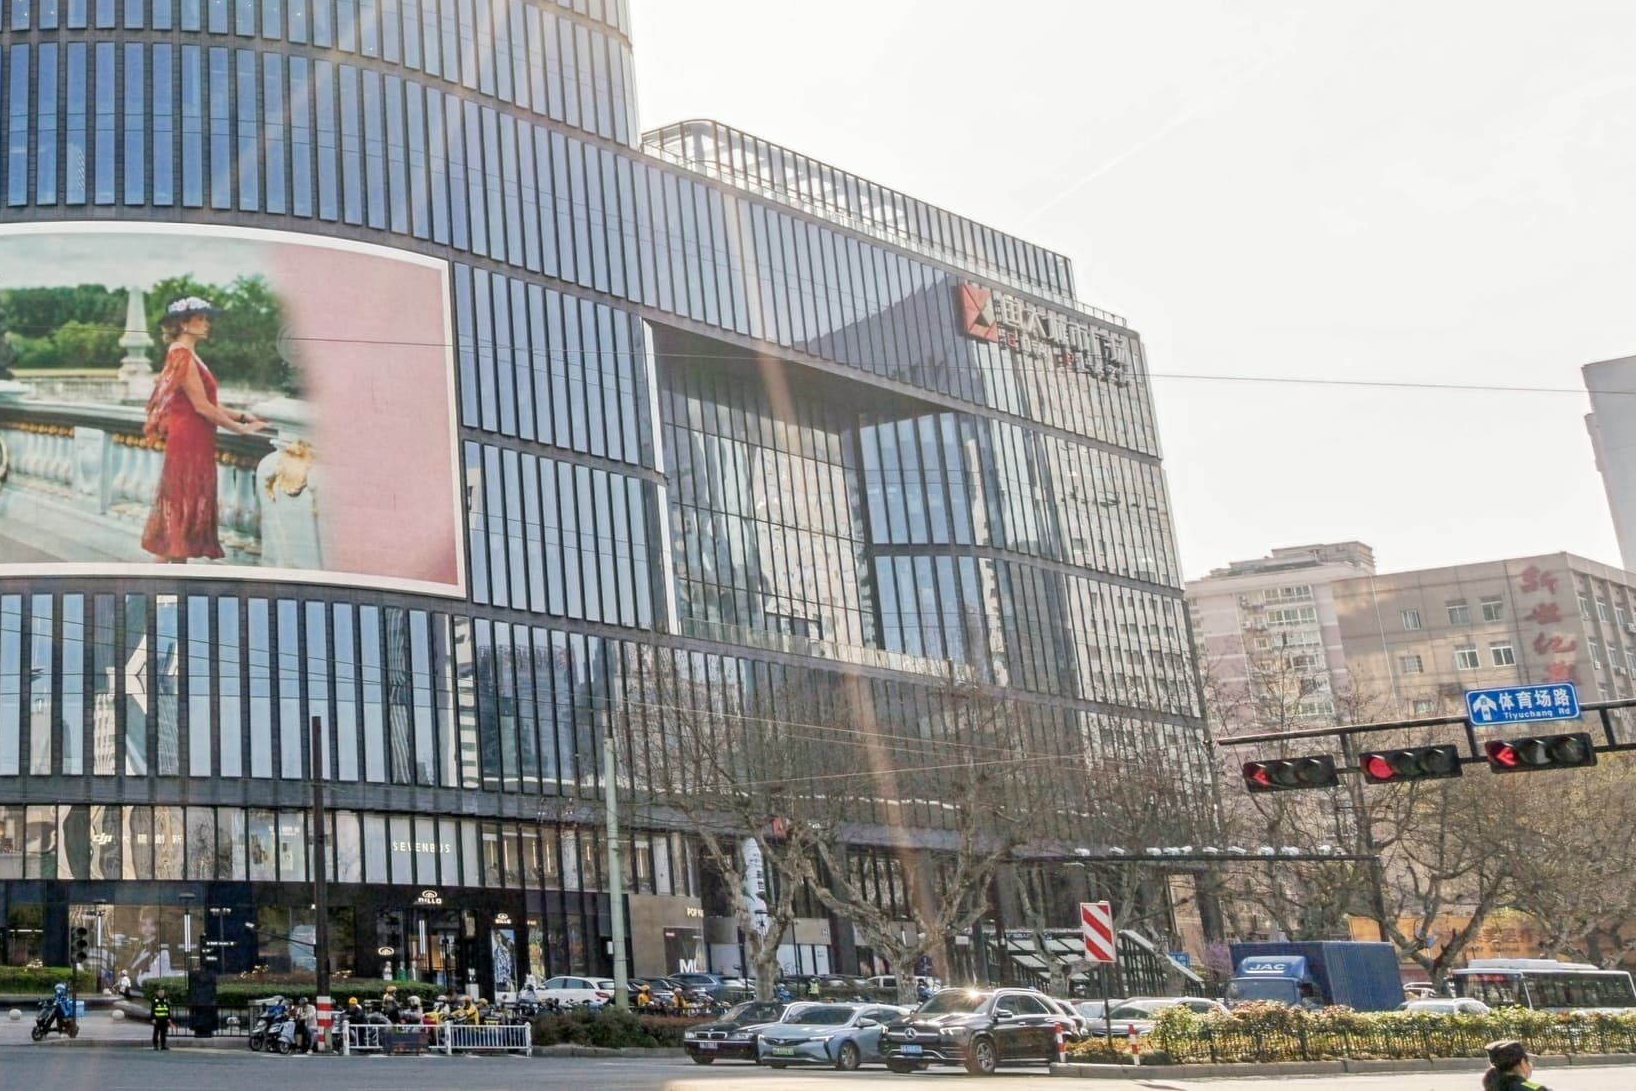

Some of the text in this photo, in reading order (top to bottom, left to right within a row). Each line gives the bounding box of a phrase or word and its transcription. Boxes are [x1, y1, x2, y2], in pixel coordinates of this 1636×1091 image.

[1498, 689, 1570, 710] 体育场路
[1504, 710, 1553, 720] Tiyuchang
[1249, 963, 1287, 971] JAC
